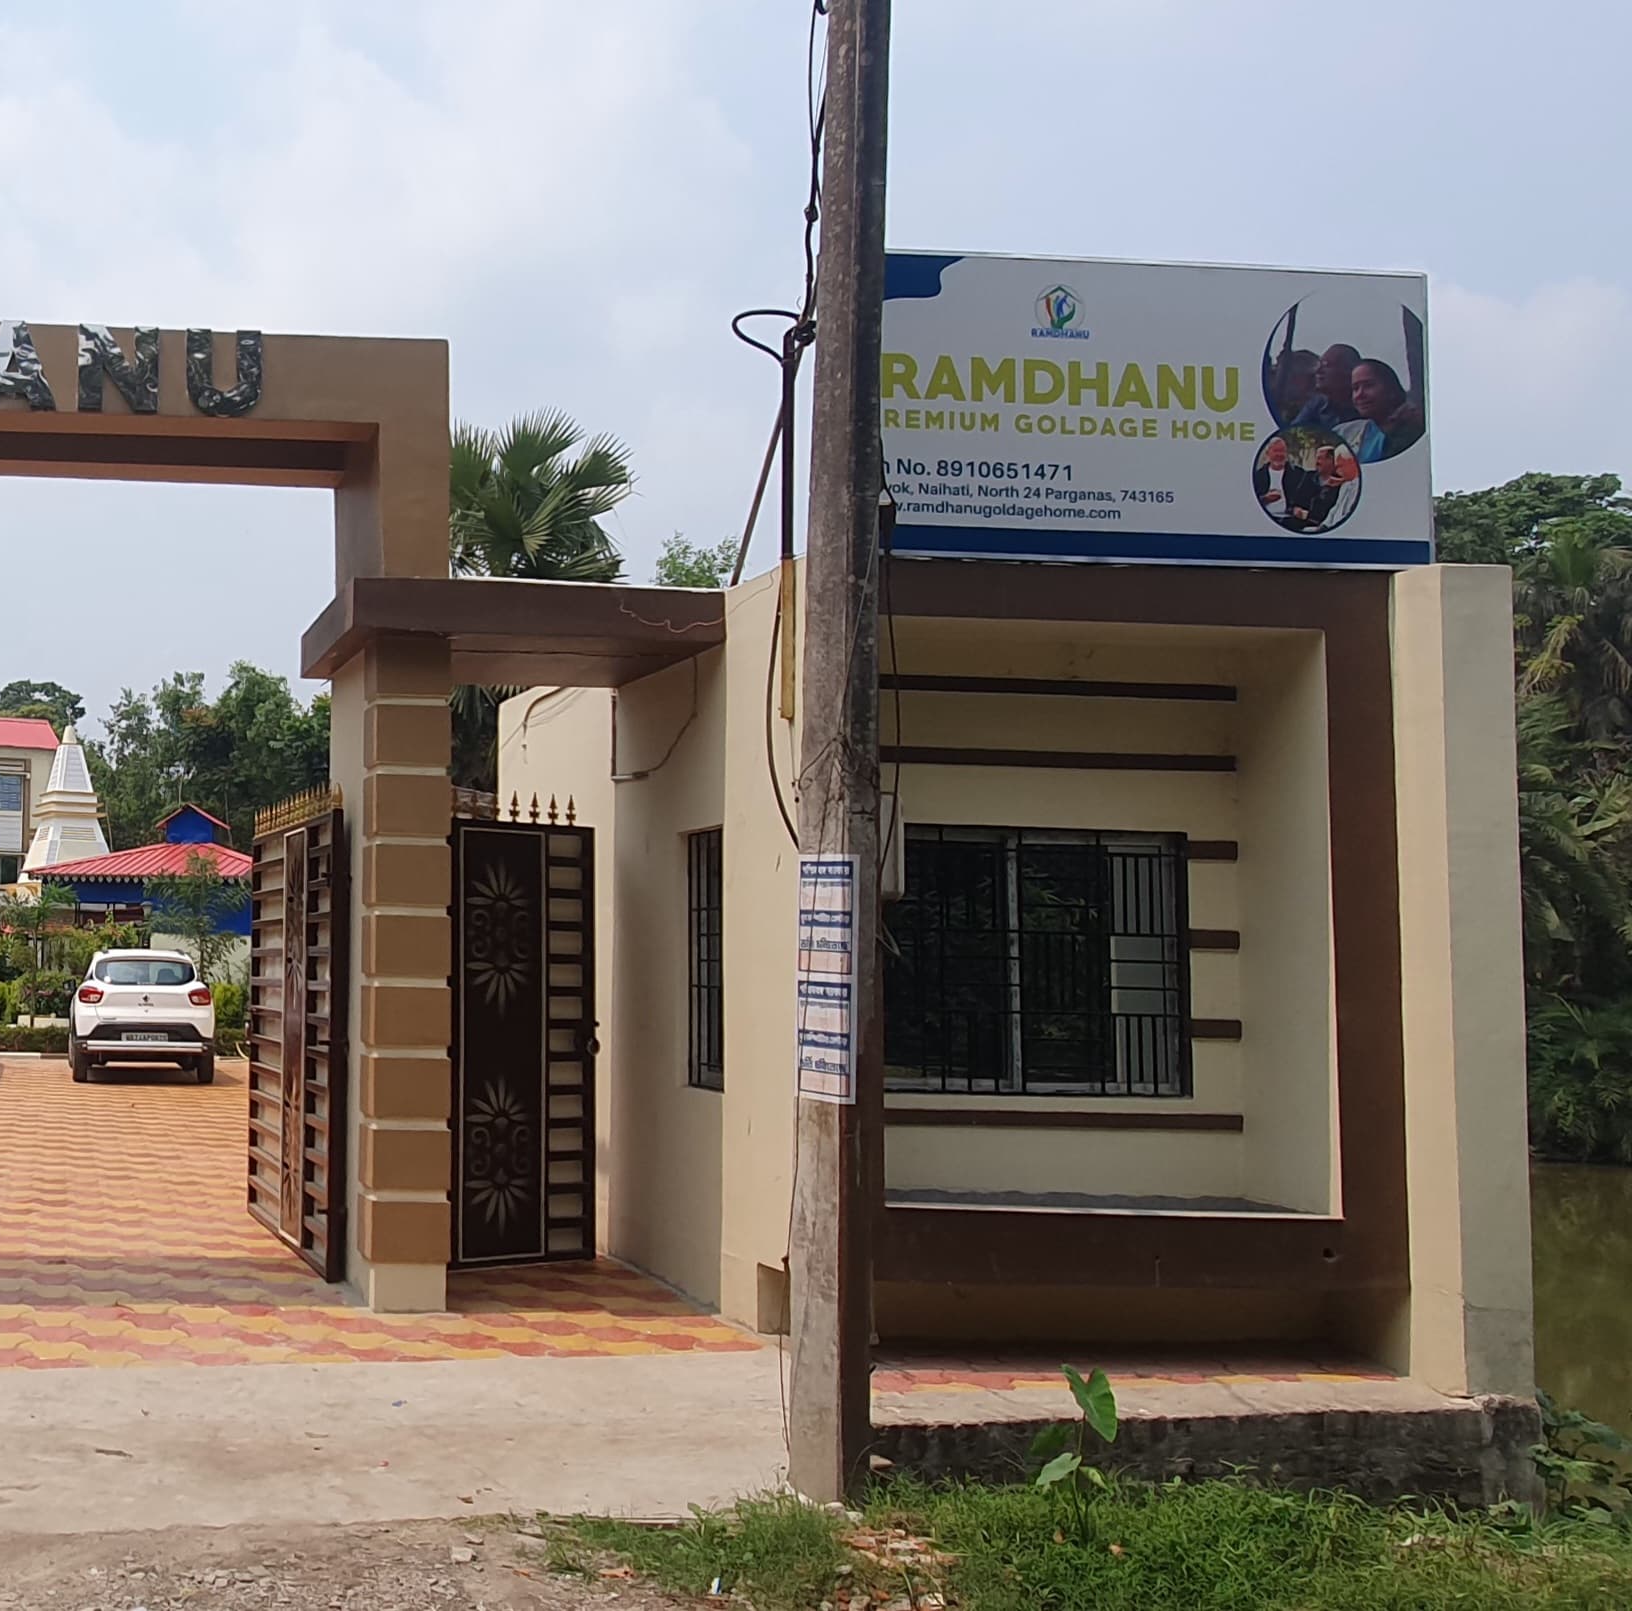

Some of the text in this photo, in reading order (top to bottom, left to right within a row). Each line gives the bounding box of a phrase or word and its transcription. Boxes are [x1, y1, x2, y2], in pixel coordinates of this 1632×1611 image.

[1031, 327, 1090, 340] RAMDHANU
[881, 352, 1239, 412] RAMDHANU
[883, 408, 1256, 441] REMIUM GOLDAGE HOME
[896, 458, 931, 475] No.
[935, 459, 1073, 482] 8910651471
[918, 482, 973, 498] Naihati,
[977, 485, 1019, 498] North
[1023, 487, 1041, 499] 24
[1045, 487, 1116, 503] Parganas,
[1119, 490, 1175, 503] 743165
